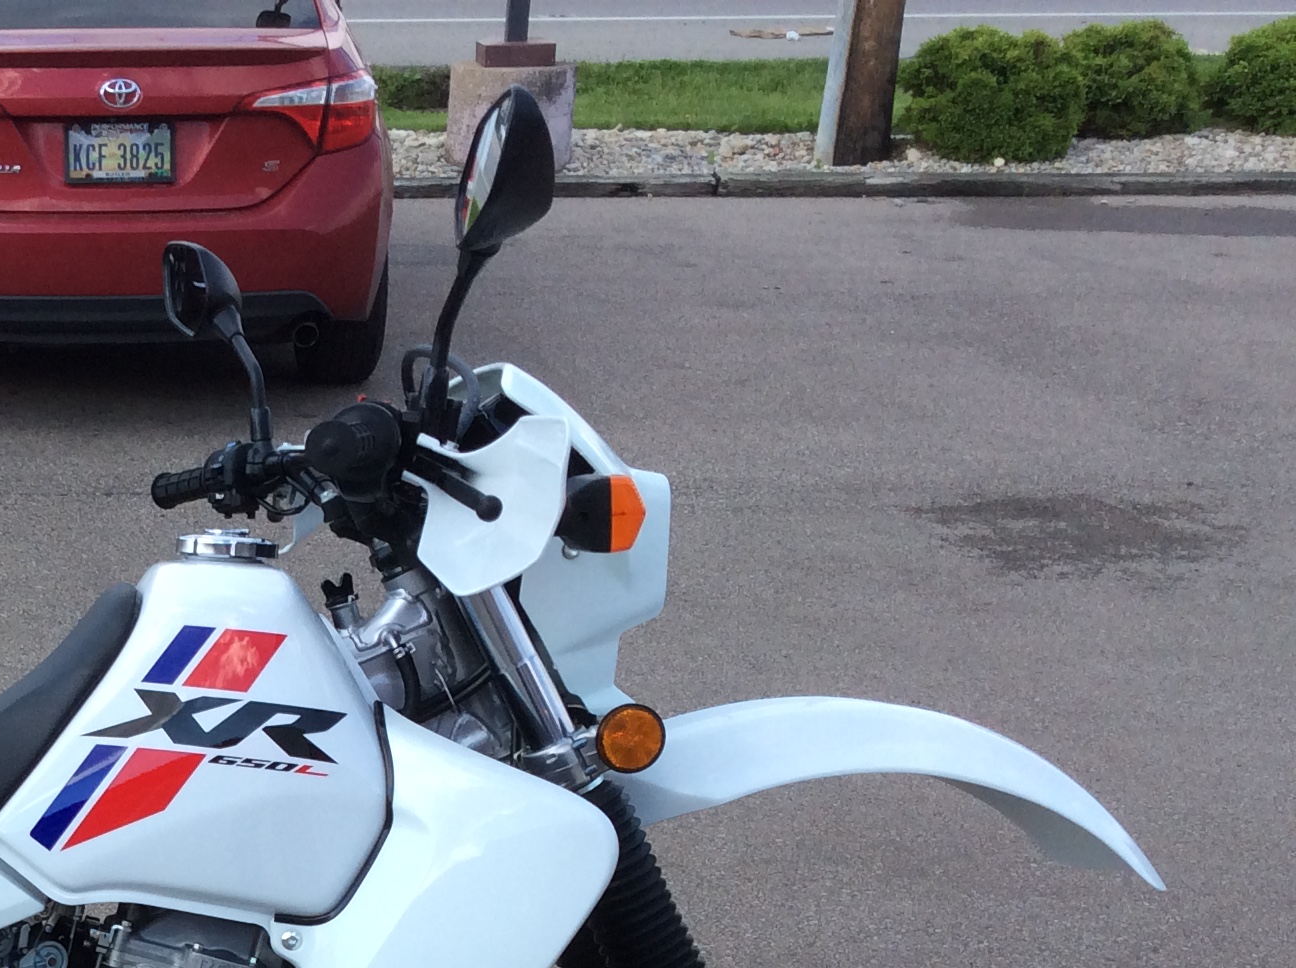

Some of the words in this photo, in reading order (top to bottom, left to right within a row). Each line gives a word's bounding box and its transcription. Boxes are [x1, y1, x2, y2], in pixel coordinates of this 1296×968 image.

[73, 143, 108, 171] KCF
[117, 143, 165, 171] 3825
[81, 688, 347, 764] XR
[207, 754, 329, 777] 650L
